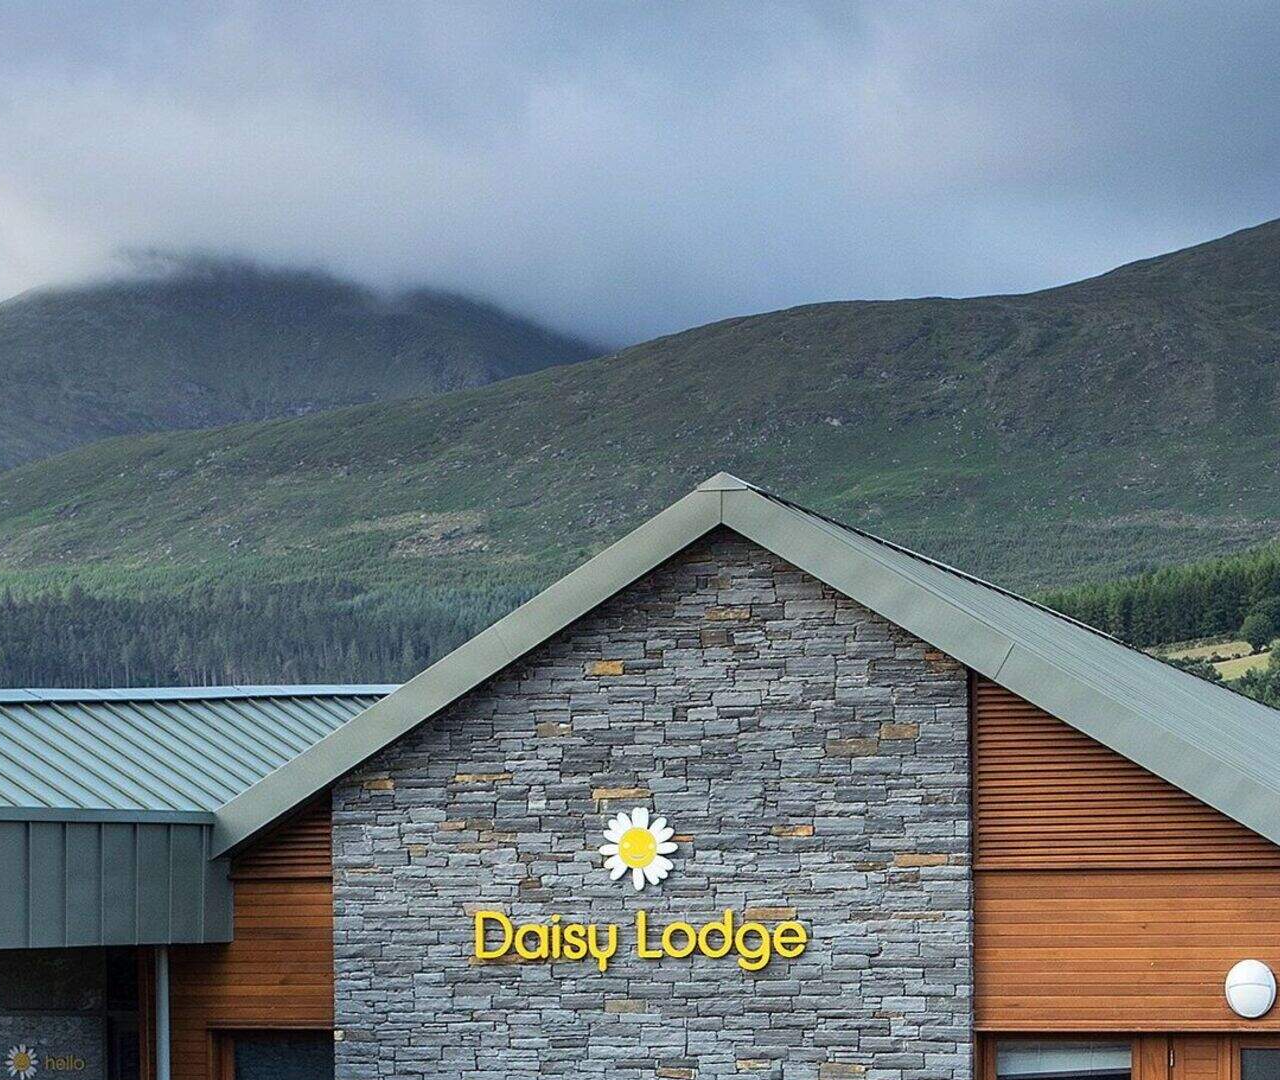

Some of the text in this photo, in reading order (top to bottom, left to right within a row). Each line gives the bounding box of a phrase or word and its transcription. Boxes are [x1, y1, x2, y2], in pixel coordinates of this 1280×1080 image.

[475, 909, 807, 972] Daisy Lodge
[45, 1055, 85, 1071] hello
